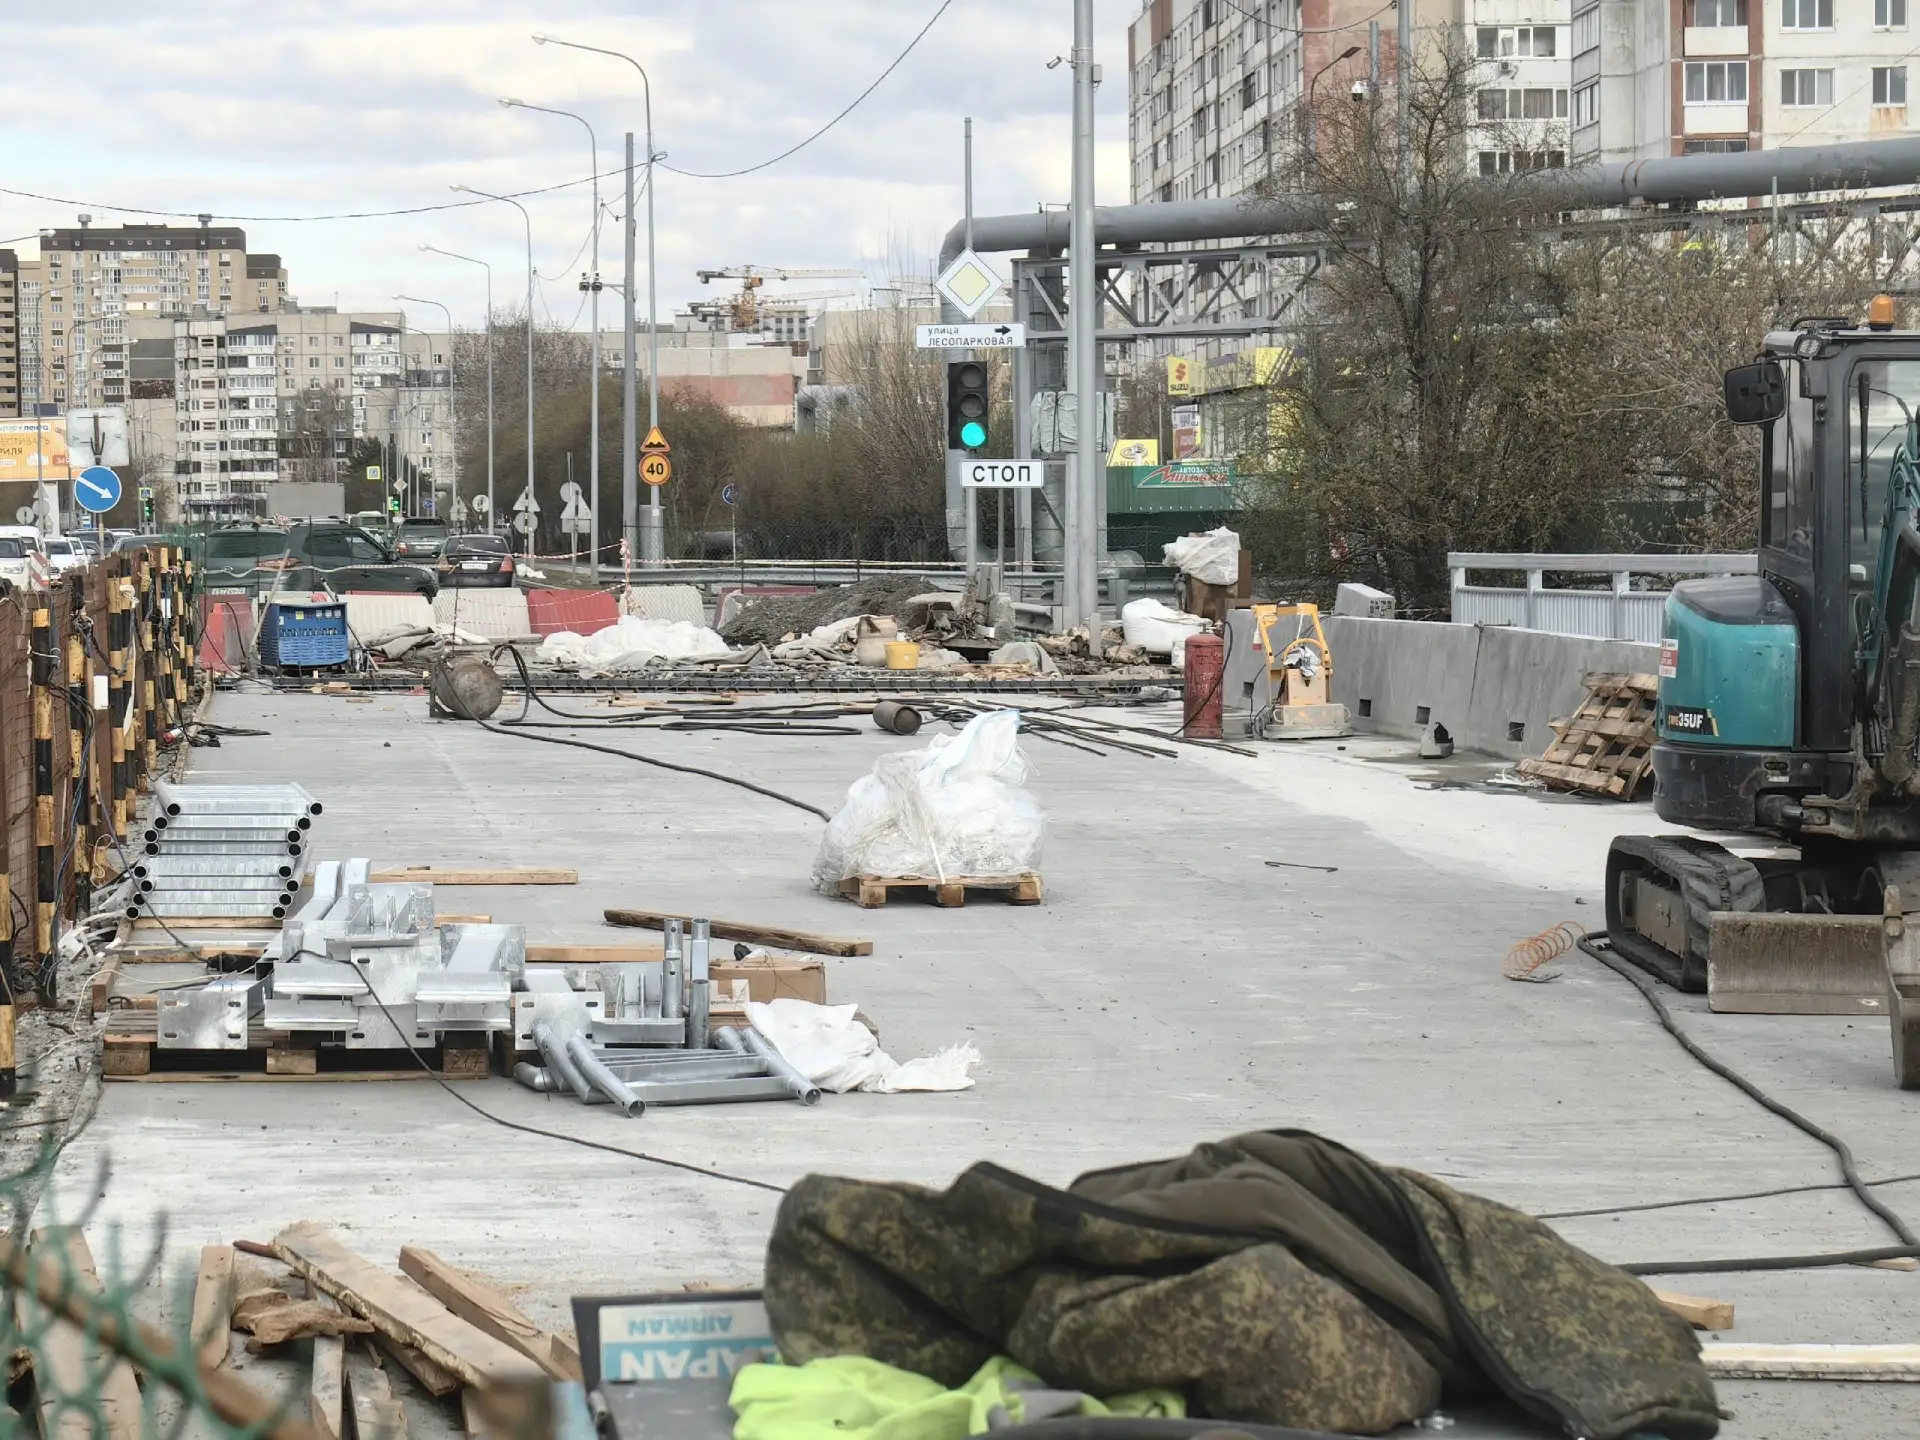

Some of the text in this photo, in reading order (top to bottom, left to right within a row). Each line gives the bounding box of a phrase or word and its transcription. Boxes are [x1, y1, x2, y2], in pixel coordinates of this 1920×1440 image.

[928, 327, 959, 335] улица
[928, 336, 1013, 347] ЛЕСОПАРКОВАЯ
[646, 463, 664, 475] 40
[972, 466, 1031, 482] СТОП
[628, 1315, 733, 1336] AIRMAN
[620, 1345, 778, 1380] APAN
